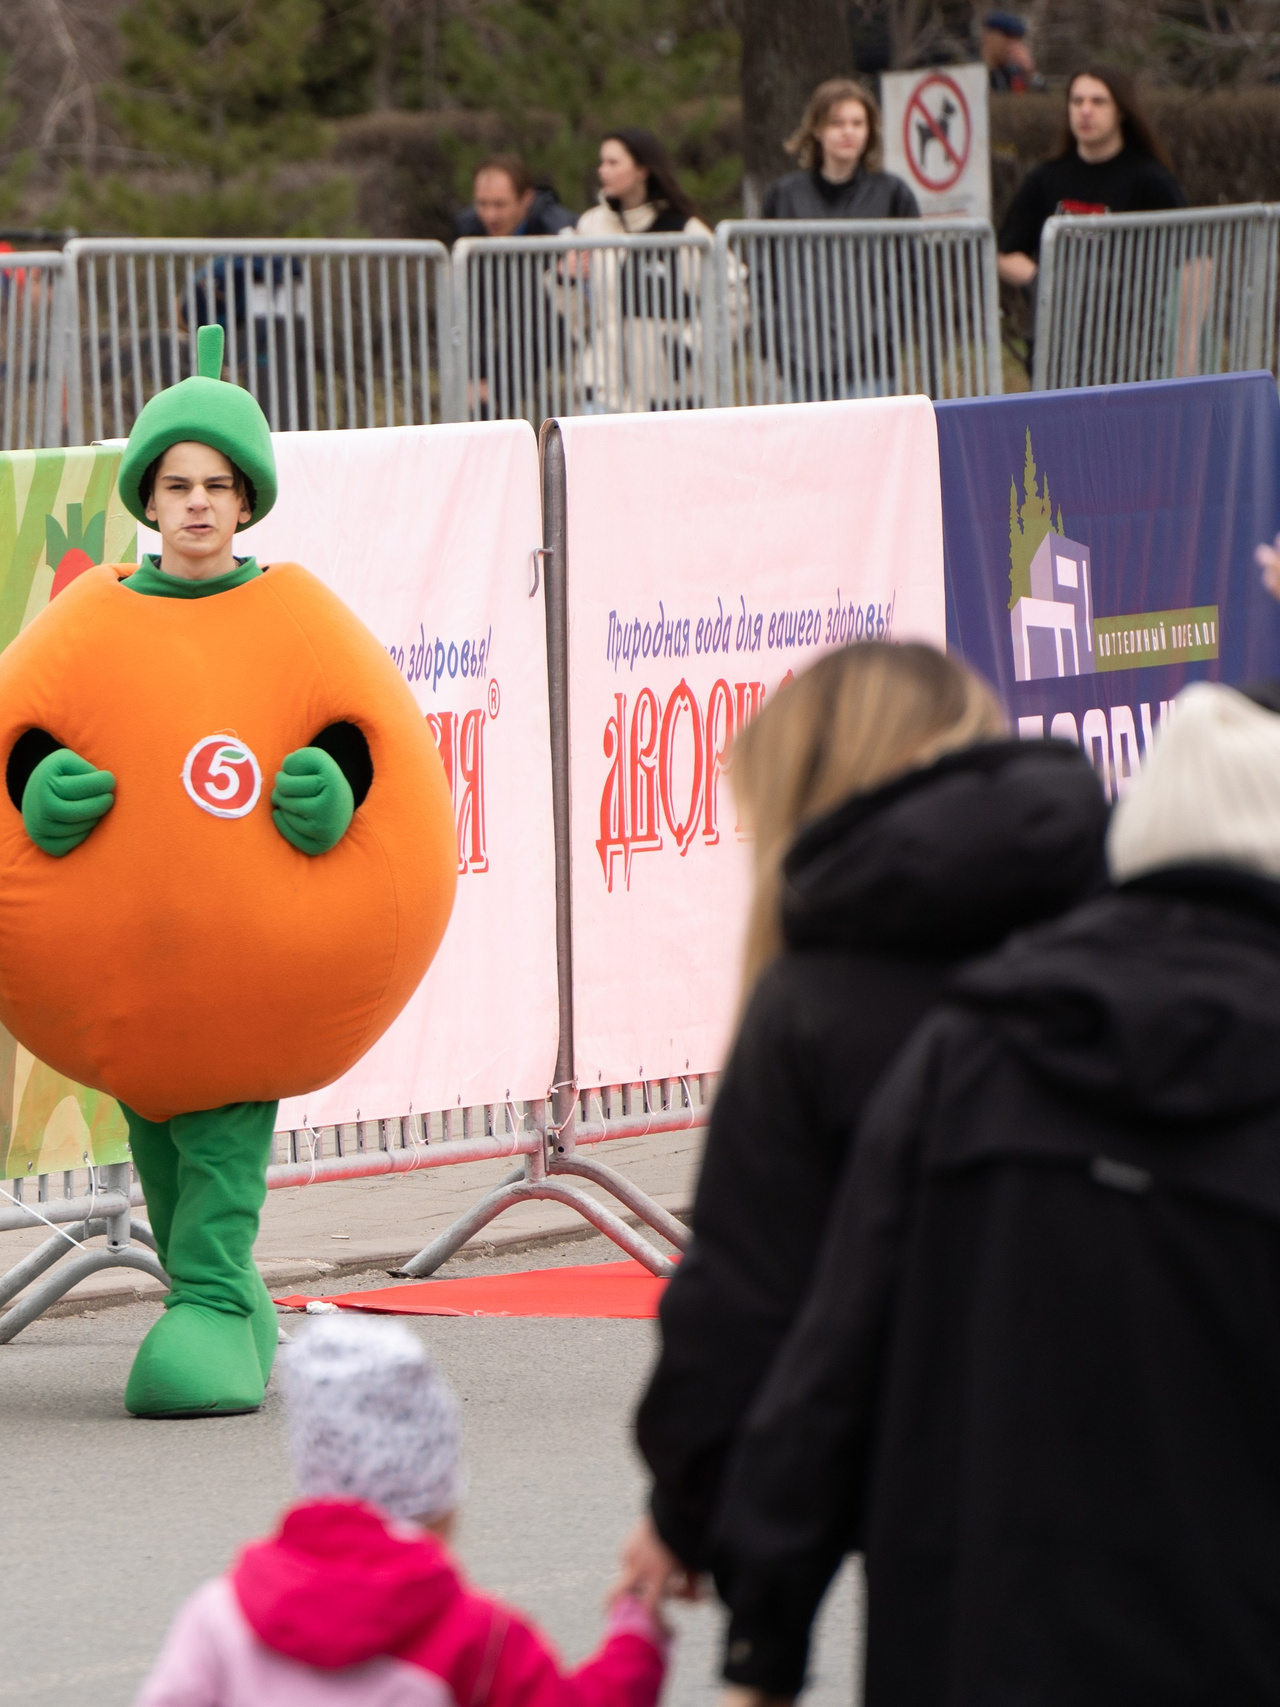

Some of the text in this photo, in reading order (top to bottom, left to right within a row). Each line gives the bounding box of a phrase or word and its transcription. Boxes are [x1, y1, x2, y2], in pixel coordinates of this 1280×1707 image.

[407, 622, 492, 693] здоровья!
[606, 600, 691, 673] Природная
[695, 596, 732, 655] вода
[736, 594, 764, 653] для
[768, 608, 821, 649] вашего
